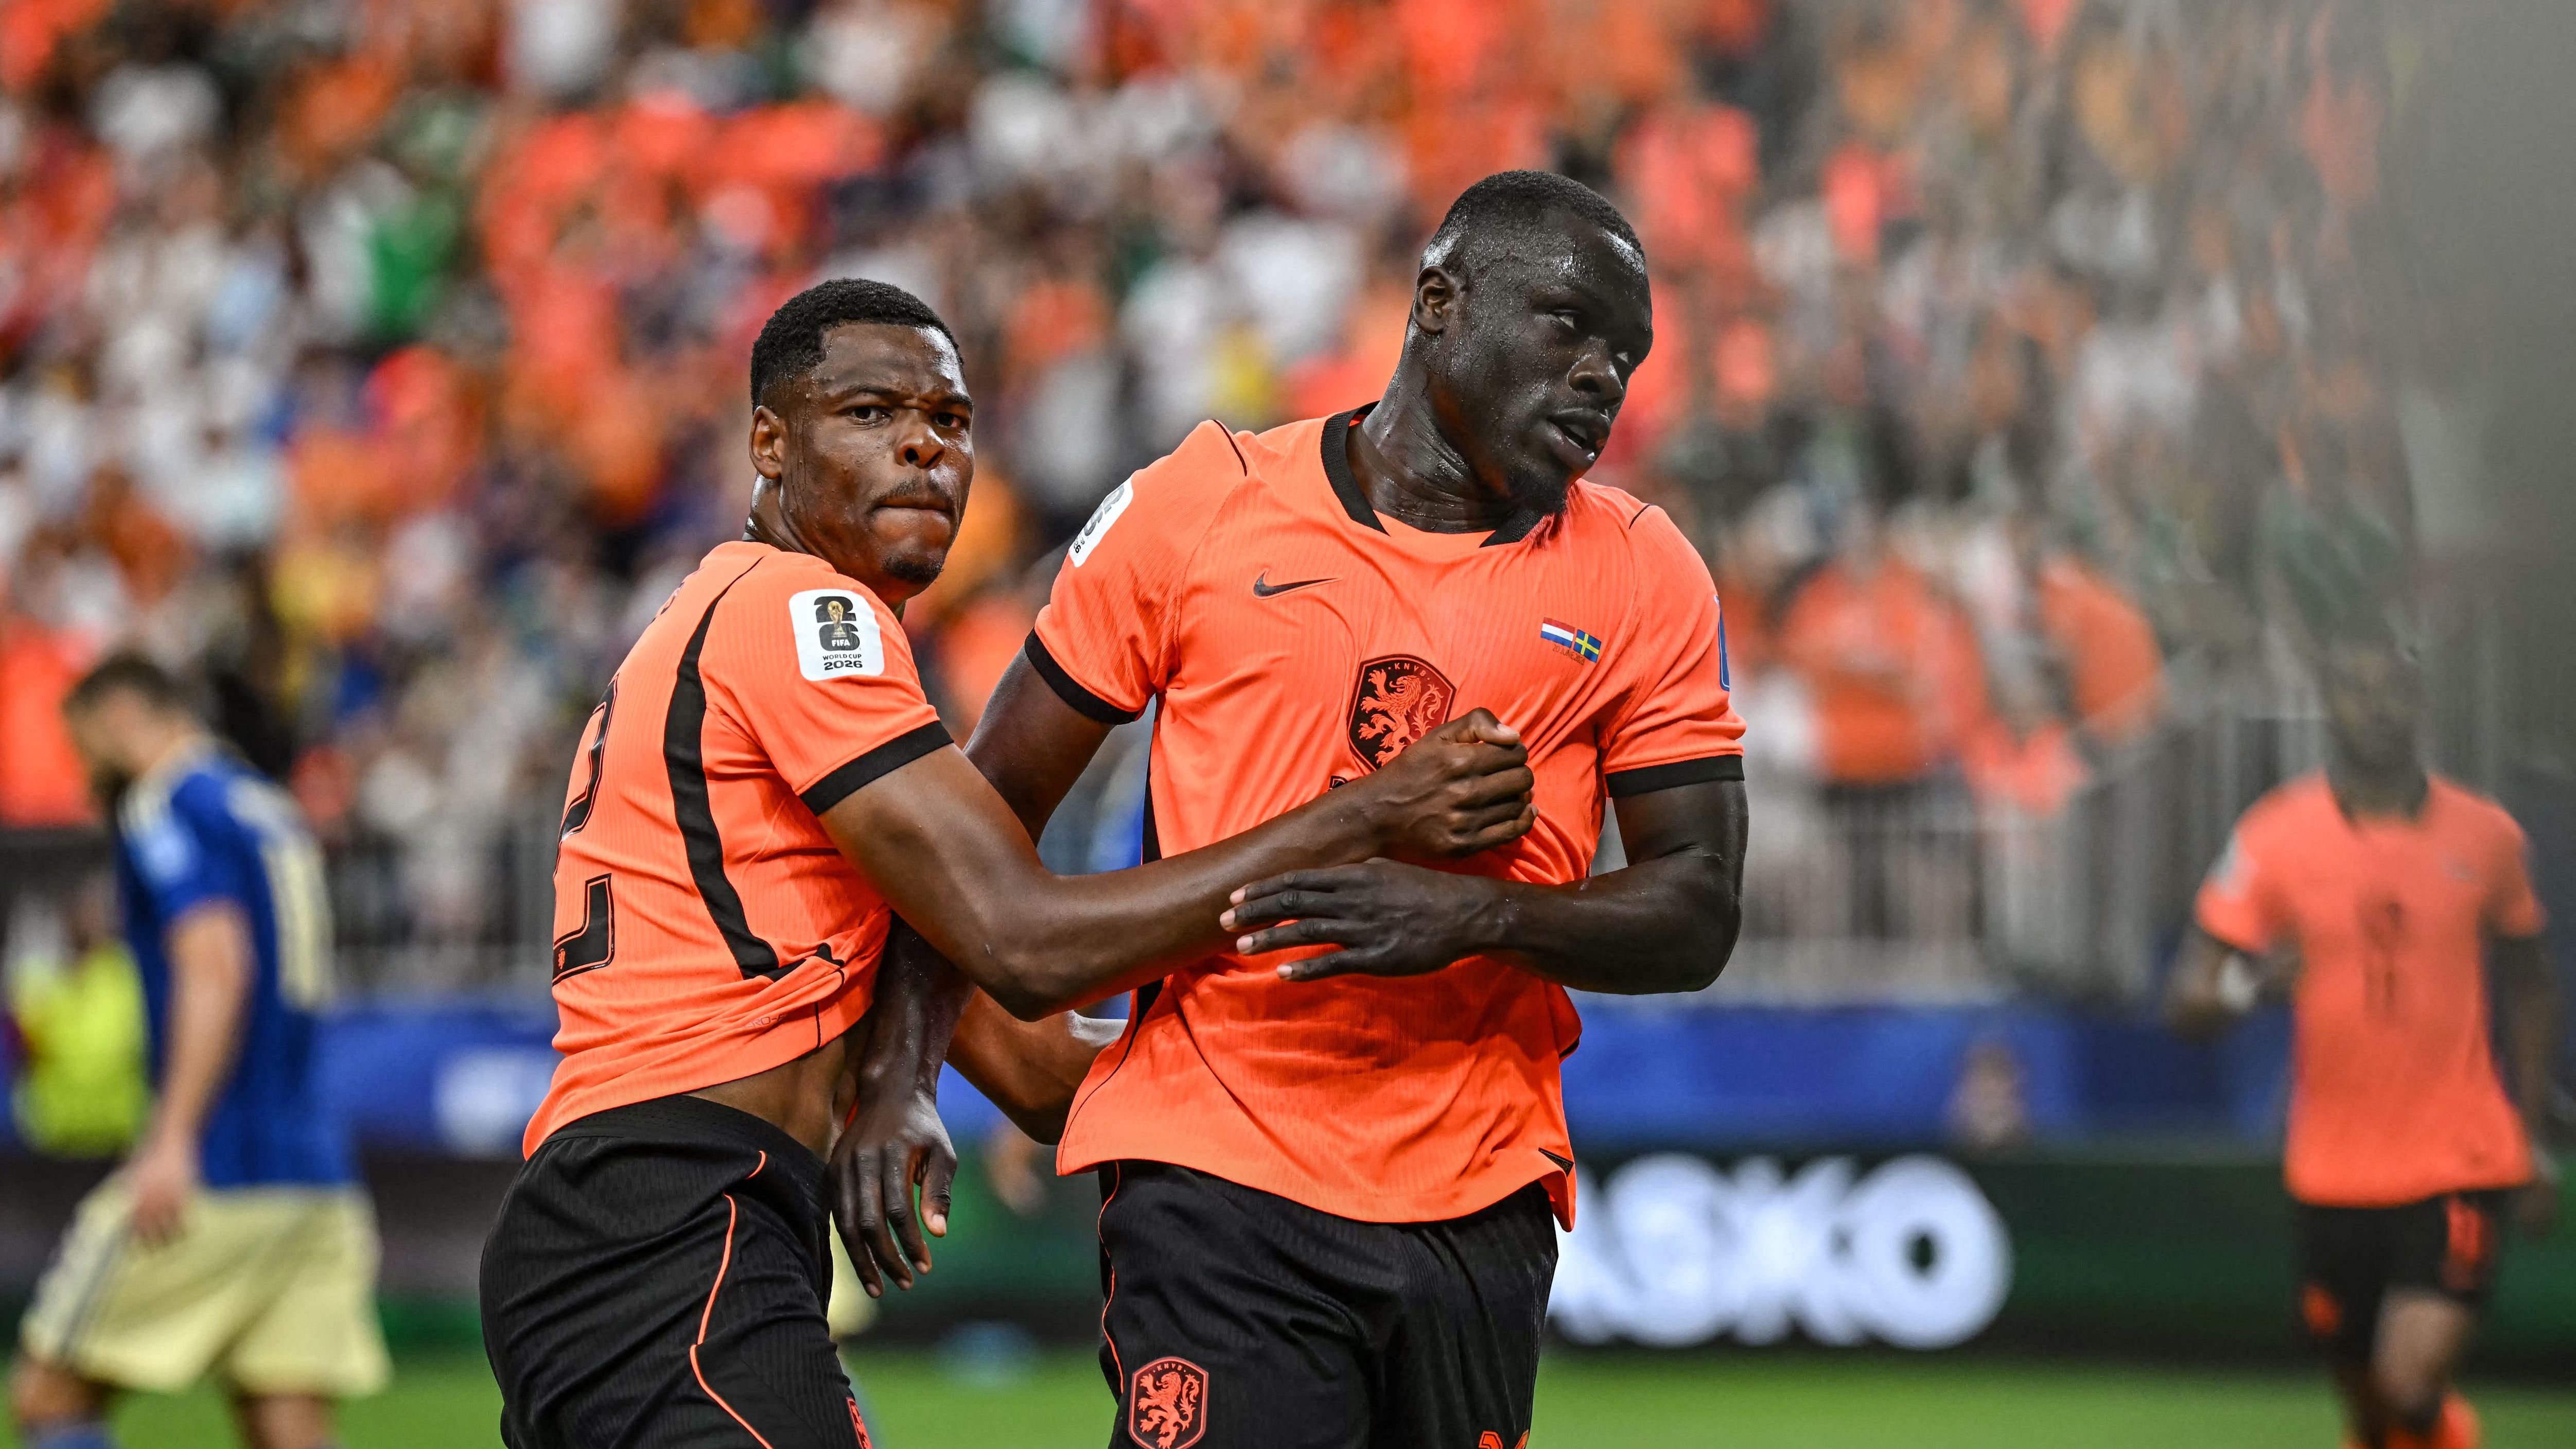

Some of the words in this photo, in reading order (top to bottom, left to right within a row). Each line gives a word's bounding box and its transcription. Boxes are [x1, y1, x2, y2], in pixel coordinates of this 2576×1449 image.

[831, 639, 850, 647] FIFA
[824, 660, 863, 671] 2026
[1394, 662, 1426, 677] KNVB
